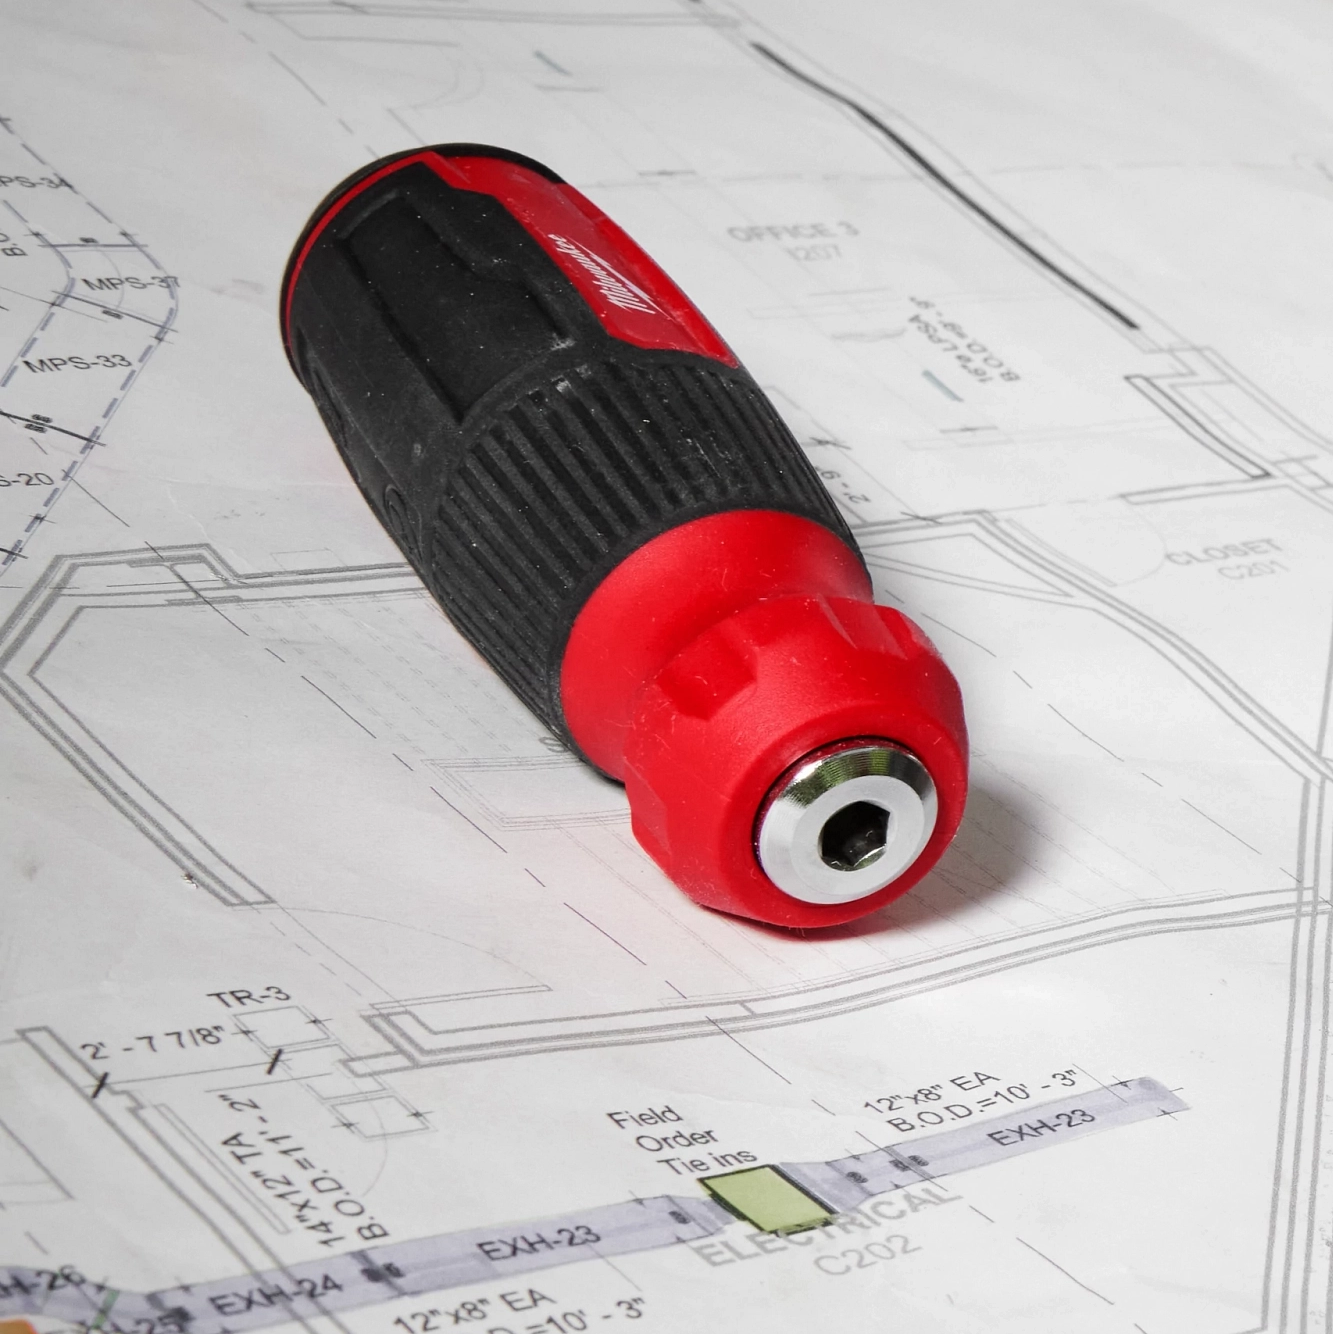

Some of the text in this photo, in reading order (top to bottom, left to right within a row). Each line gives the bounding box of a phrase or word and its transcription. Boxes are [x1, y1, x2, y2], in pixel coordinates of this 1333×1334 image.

[547, 233, 656, 315] Milwaukee
[22, 354, 133, 373] MPS-33
[1165, 538, 1283, 566] CLOSET
[206, 985, 292, 1009] TR-3
[864, 1071, 1002, 1115] 12"x8" EA
[605, 1104, 684, 1130] Field
[988, 1109, 1096, 1146] EXH-23
[220, 1131, 263, 1166] TA
[635, 1126, 719, 1152] Order
[657, 1148, 759, 1176] Tie ins
[476, 1224, 601, 1262] EXH-23
[691, 1186, 964, 1268] ELECTRICAL
[813, 1234, 922, 1277] C202
[208, 1273, 344, 1317] EXH-24
[393, 1288, 557, 1334] 12"x8" EA
